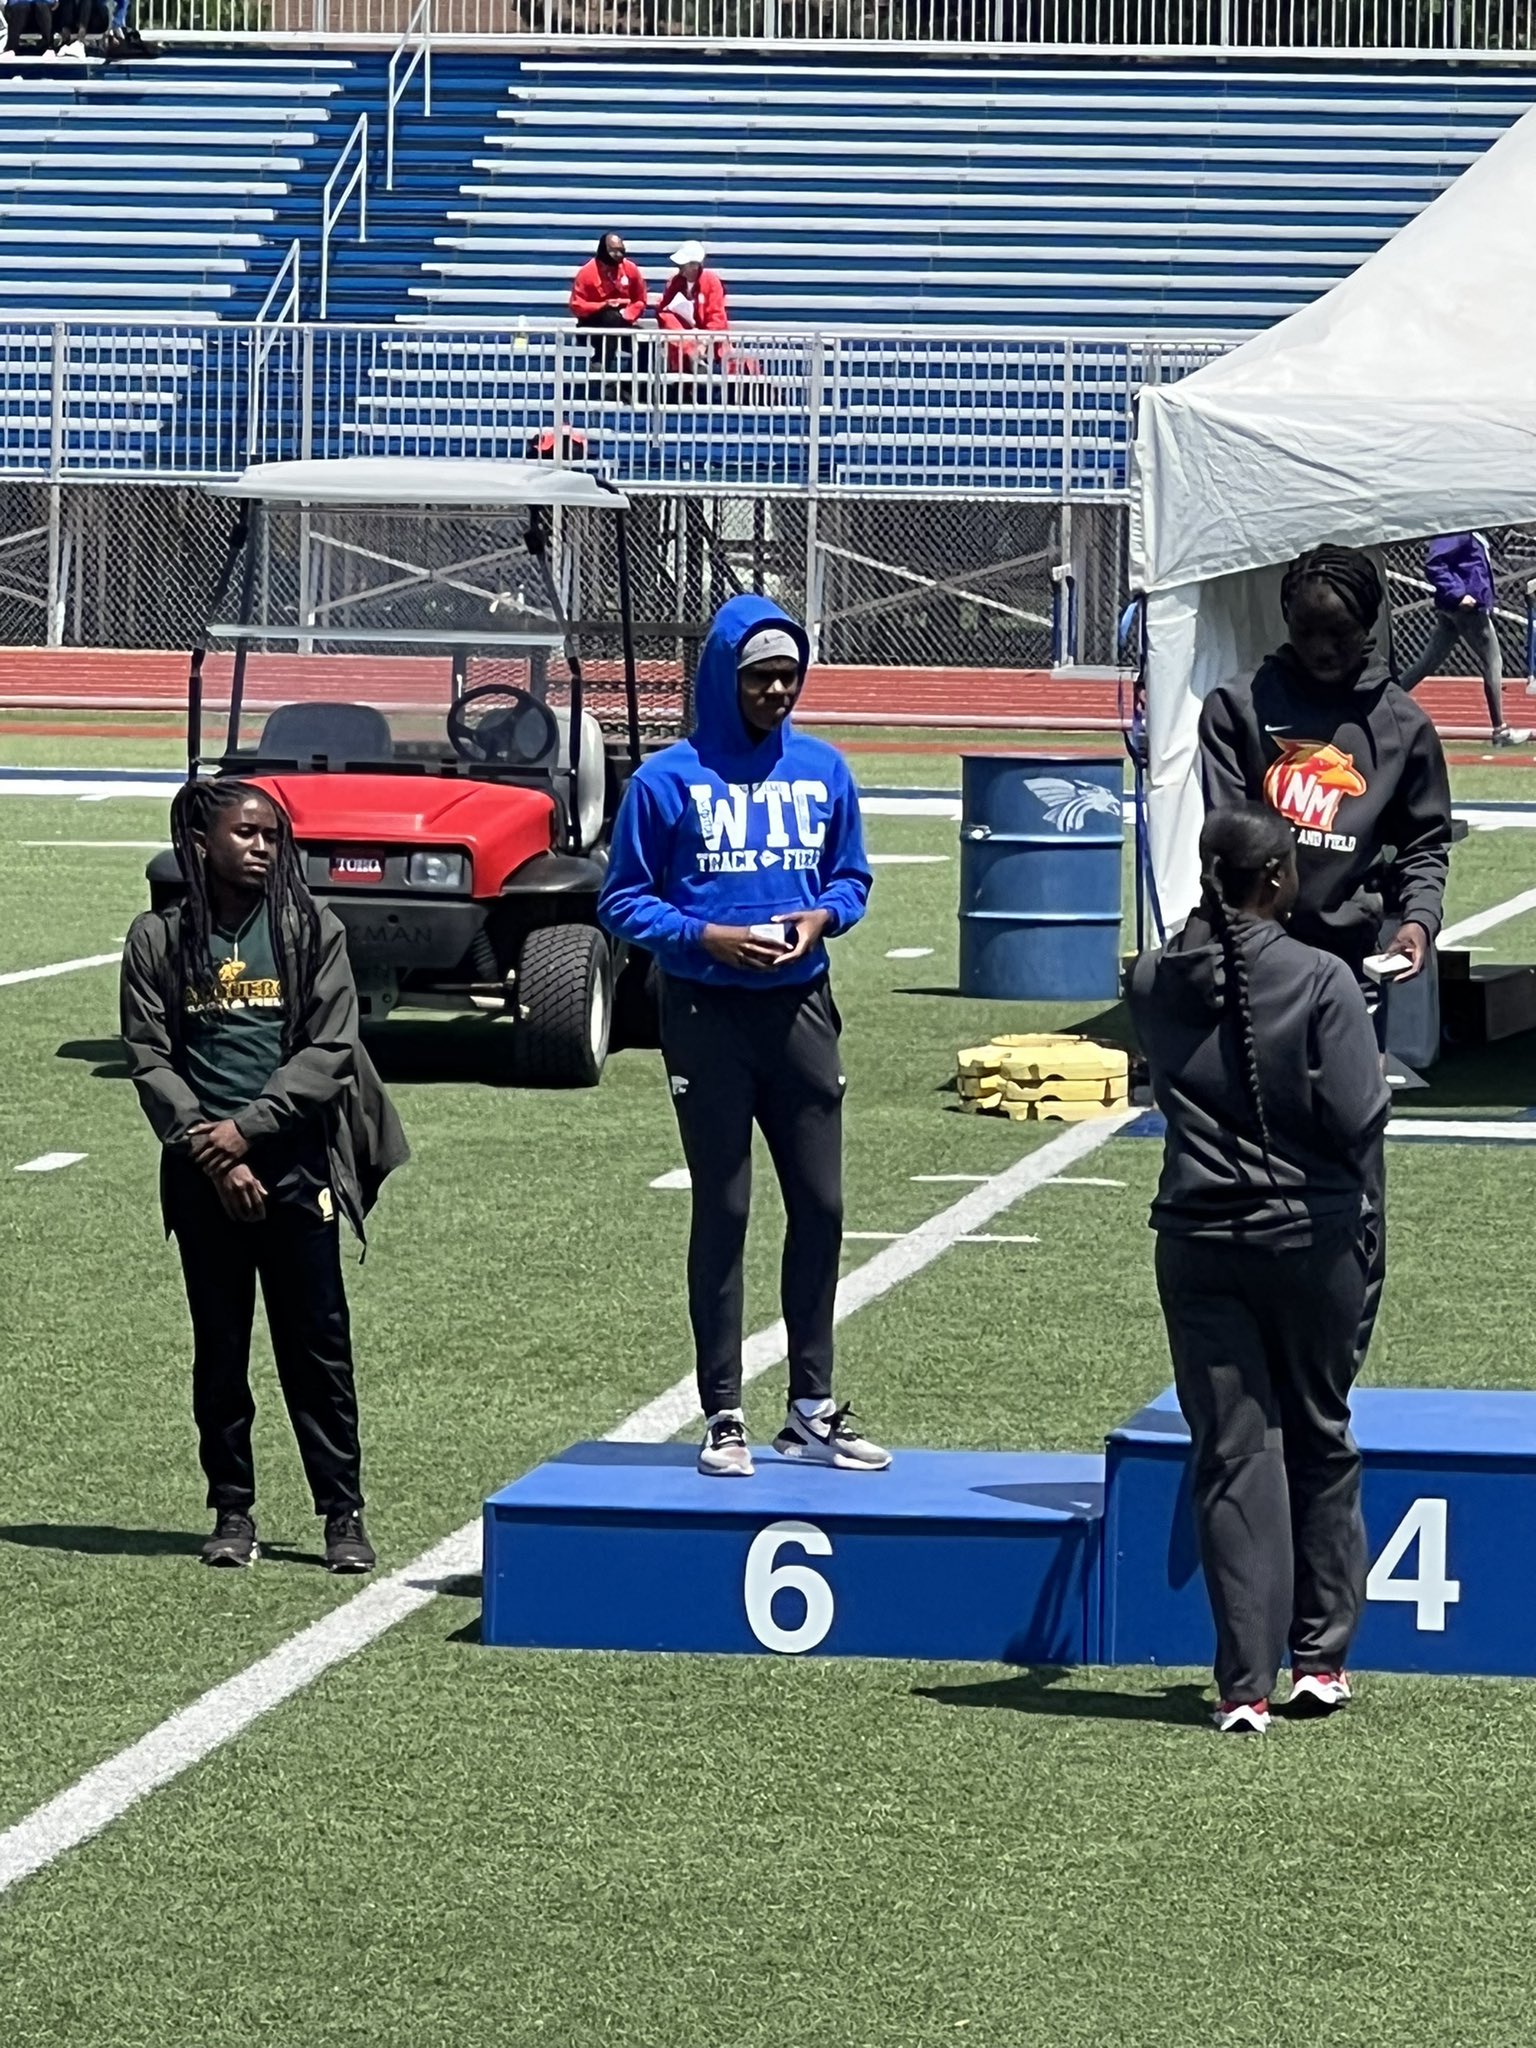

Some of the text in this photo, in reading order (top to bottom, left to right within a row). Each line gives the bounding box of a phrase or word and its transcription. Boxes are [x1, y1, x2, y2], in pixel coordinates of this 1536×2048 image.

[689, 780, 828, 850] WTC
[1280, 771, 1340, 827] NM
[335, 857, 382, 872] TORO
[696, 850, 758, 873] TRACK
[1297, 829, 1357, 852] AND FIELD
[744, 1521, 834, 1653] 6
[1366, 1498, 1459, 1631] 4
